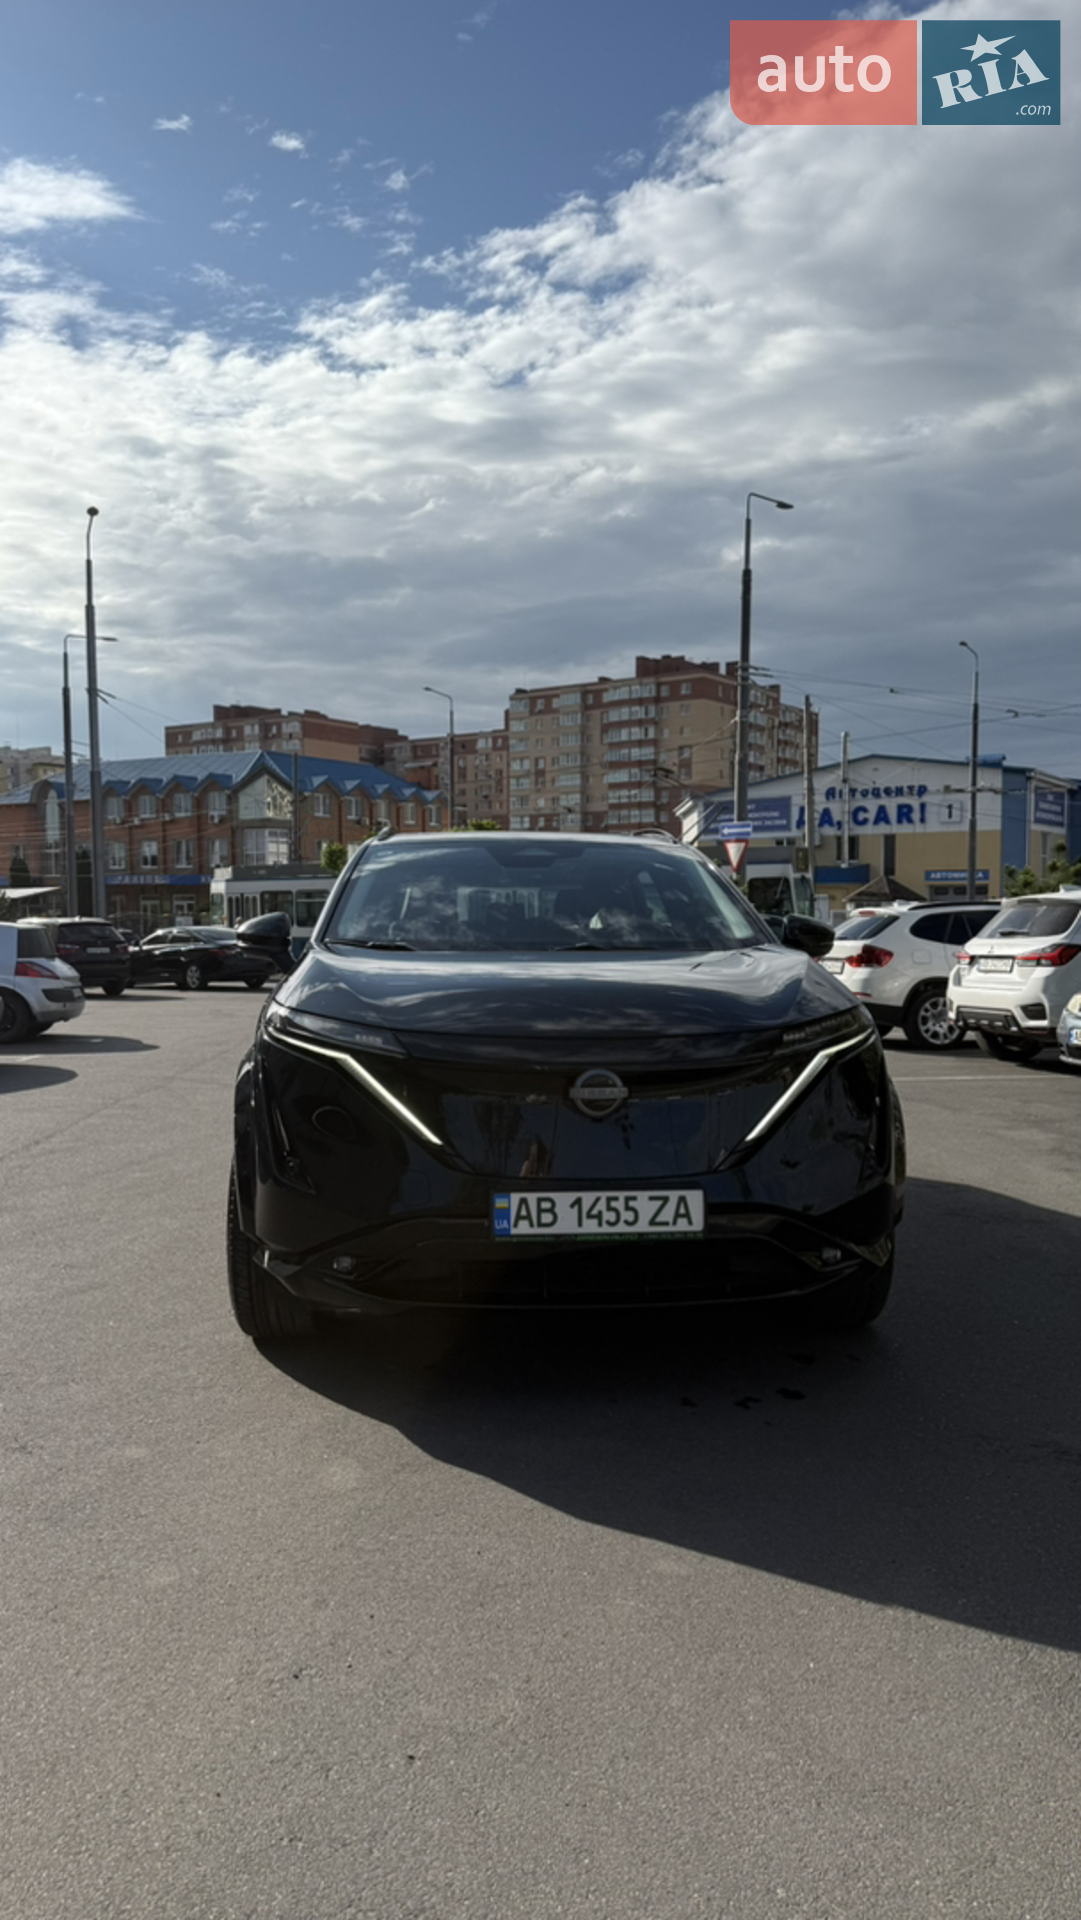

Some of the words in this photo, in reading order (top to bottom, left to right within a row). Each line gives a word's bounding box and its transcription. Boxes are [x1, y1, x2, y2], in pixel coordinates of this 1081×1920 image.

[852, 802, 927, 826] CAR!
[946, 804, 954, 819] 1
[929, 871, 984, 879] АВТОМИА
[513, 1197, 558, 1228] AB
[569, 1196, 639, 1228] 1455
[648, 1195, 693, 1226] ZA
[494, 1219, 509, 1230] UA
